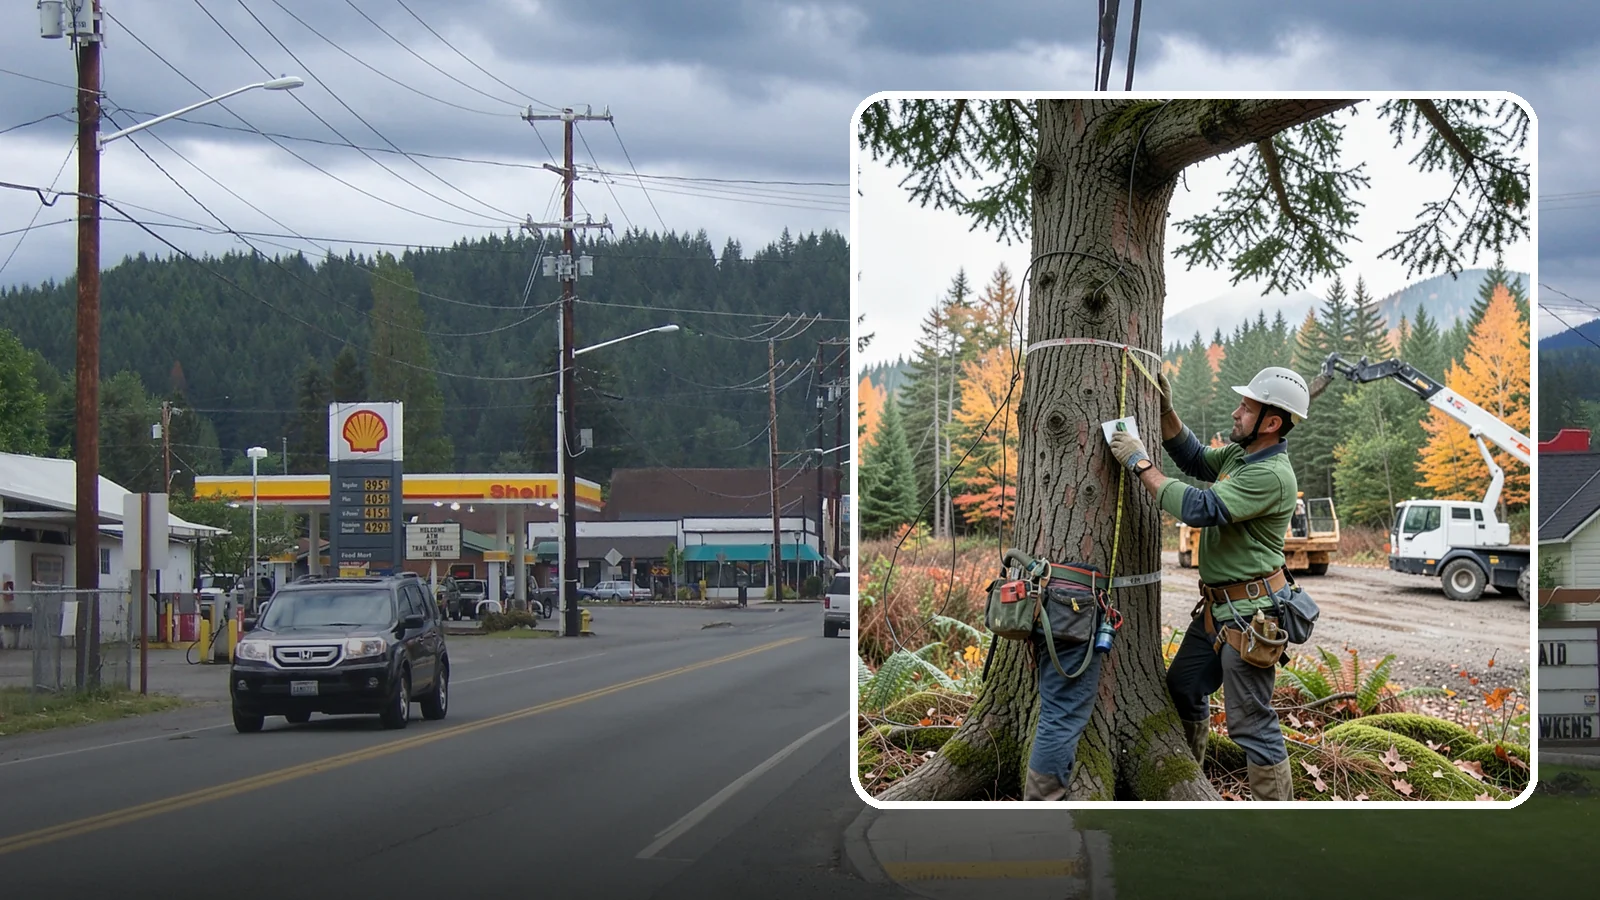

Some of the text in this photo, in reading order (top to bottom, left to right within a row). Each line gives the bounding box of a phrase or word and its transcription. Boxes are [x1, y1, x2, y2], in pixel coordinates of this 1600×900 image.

[365, 480, 384, 490] 395
[490, 484, 547, 499] Shell
[365, 494, 384, 504] 405
[365, 508, 384, 518] 415
[365, 522, 384, 532] 429
